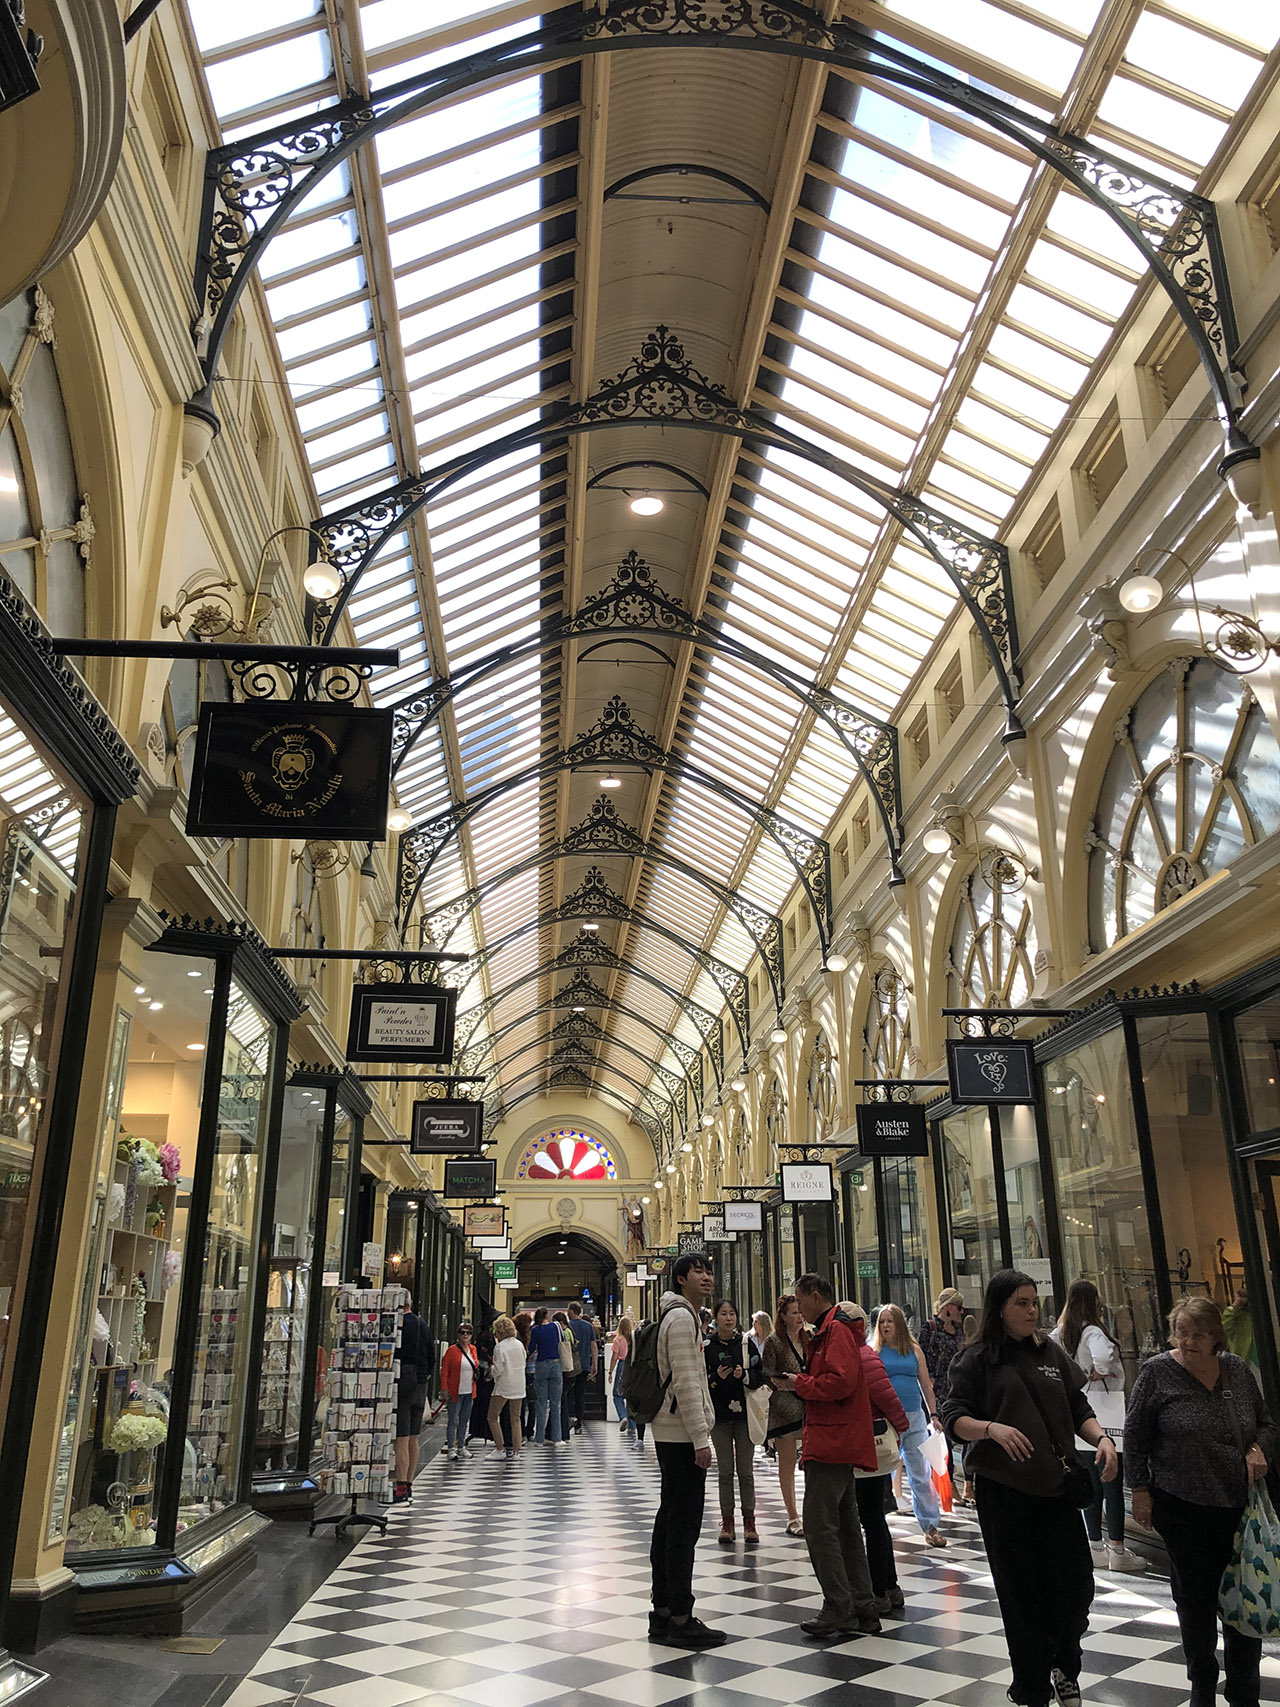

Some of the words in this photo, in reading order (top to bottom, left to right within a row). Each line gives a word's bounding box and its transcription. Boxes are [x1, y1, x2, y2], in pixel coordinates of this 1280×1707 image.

[237, 769, 263, 807] Santa
[260, 802, 305, 818] Maria
[304, 774, 344, 817] Novella
[383, 1015, 413, 1025] Powder
[874, 1120, 909, 1128] Austen
[875, 1128, 910, 1136] &Blake
[452, 1176, 486, 1184] MATCHA
[790, 1181, 825, 1189] REIGNE
